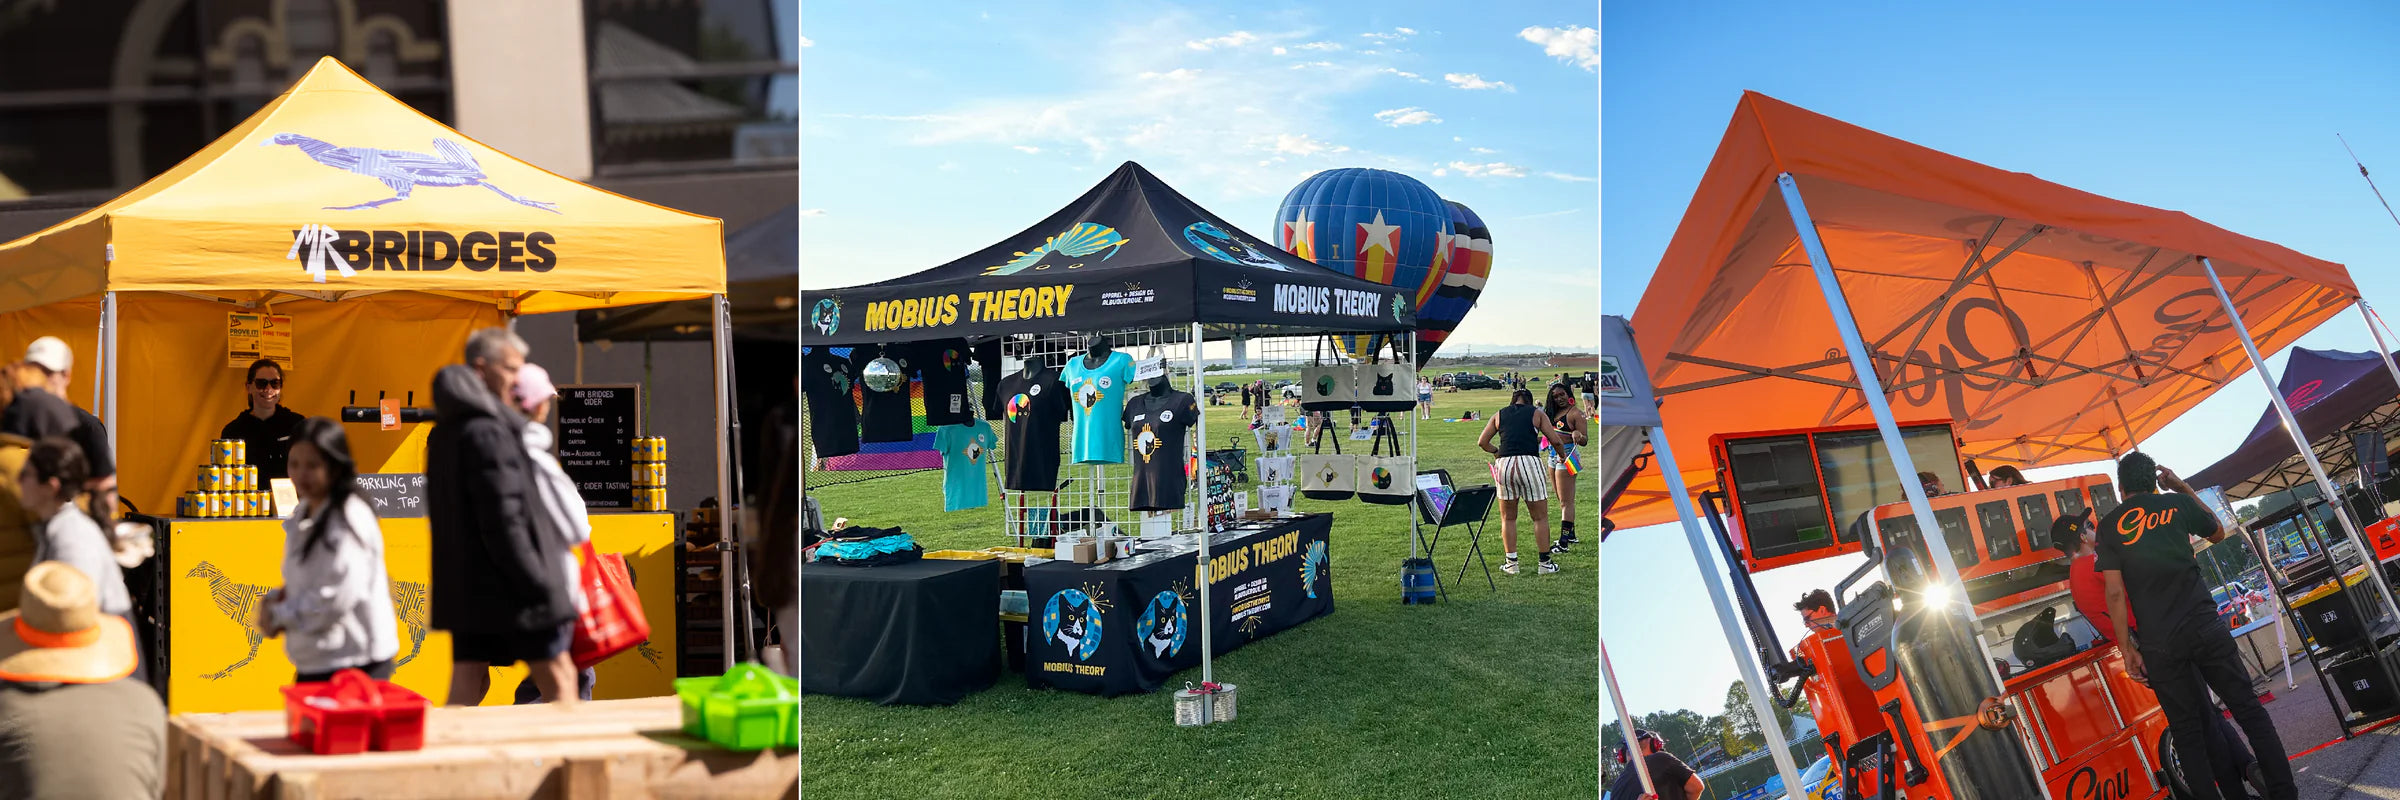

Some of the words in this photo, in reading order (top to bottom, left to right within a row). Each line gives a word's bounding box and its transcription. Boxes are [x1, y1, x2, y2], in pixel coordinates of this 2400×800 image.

[286, 224, 357, 283] MR
[338, 230, 557, 272] BRIDGES
[865, 294, 960, 331] MOBIUS
[968, 284, 1074, 322] THEORY
[1273, 284, 1330, 315] MOBIUS
[1334, 288, 1382, 317] THEORY
[357, 476, 407, 494] PARKLING
[584, 482, 602, 490] CIDER
[606, 482, 630, 490] TASTING
[398, 496, 420, 508] TAP
[1253, 530, 1300, 567] THEORY
[1044, 662, 1073, 673] MOBIUS
[1075, 664, 1107, 676] THEORY
